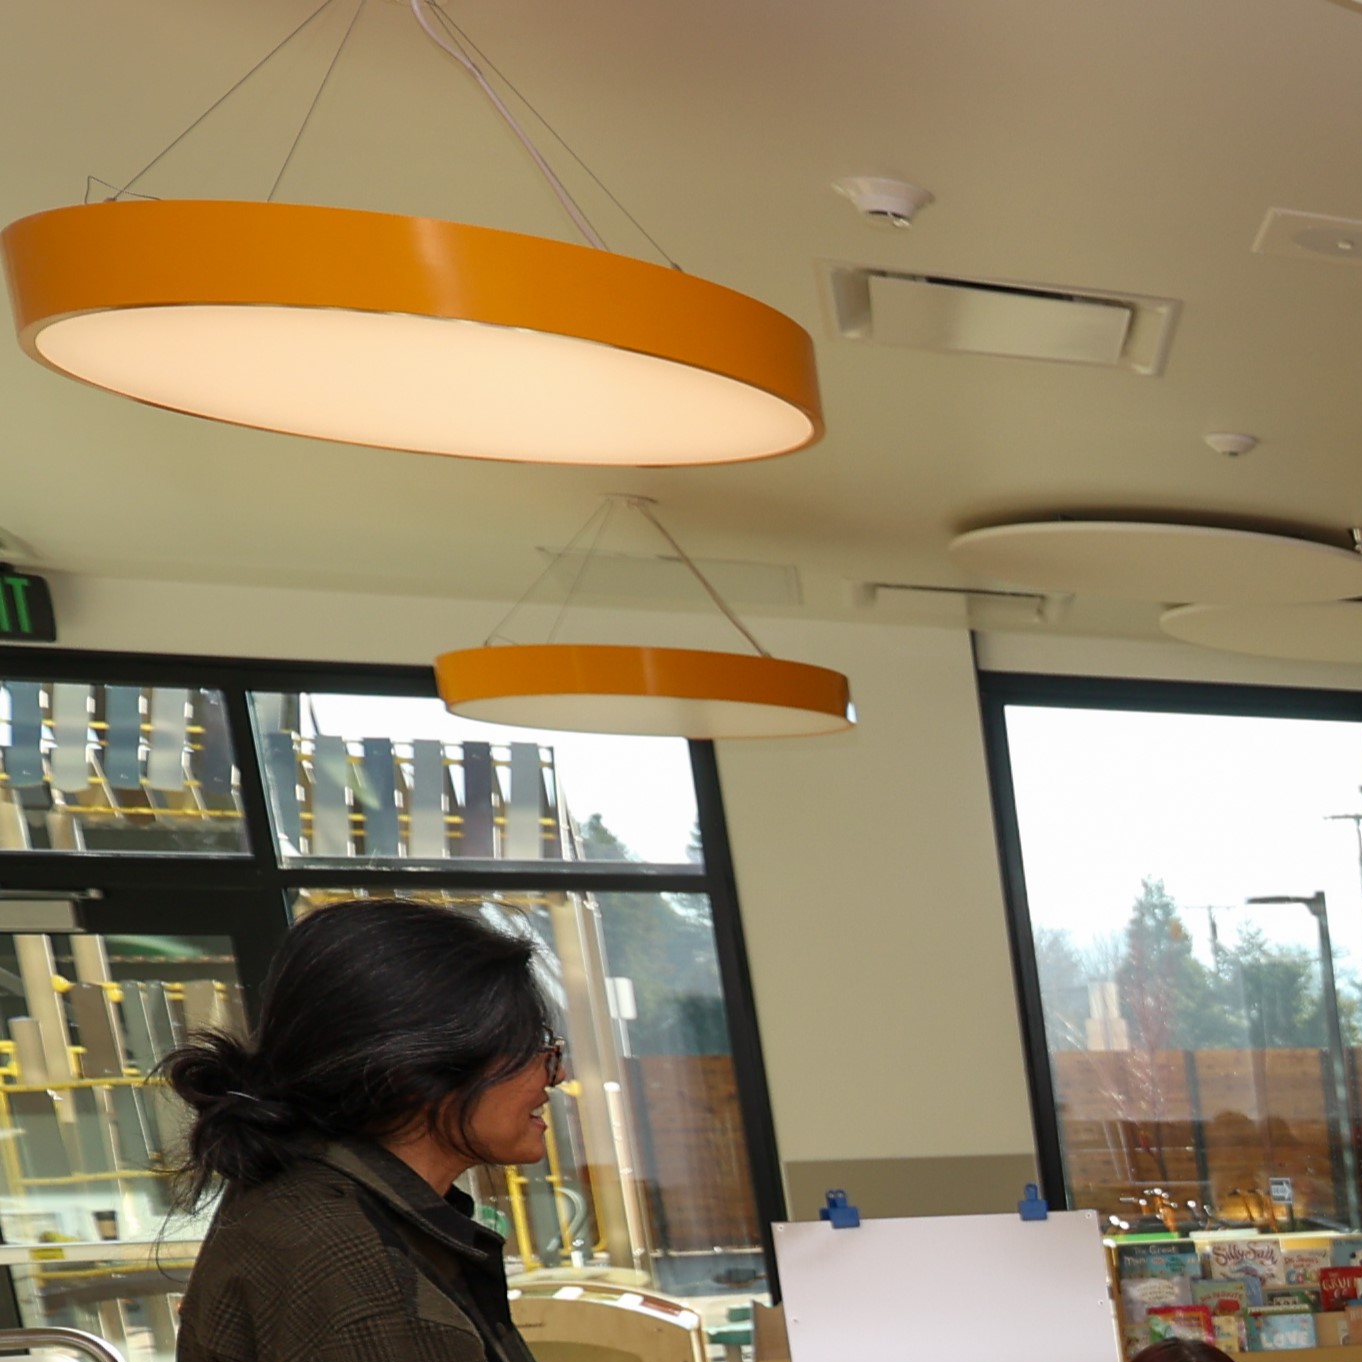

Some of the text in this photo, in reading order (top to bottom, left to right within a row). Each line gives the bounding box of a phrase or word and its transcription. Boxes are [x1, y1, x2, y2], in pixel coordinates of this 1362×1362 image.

[1149, 1244, 1176, 1255] Great
[1212, 1244, 1245, 1266] Silly
[1260, 1330, 1309, 1348] LOVE
